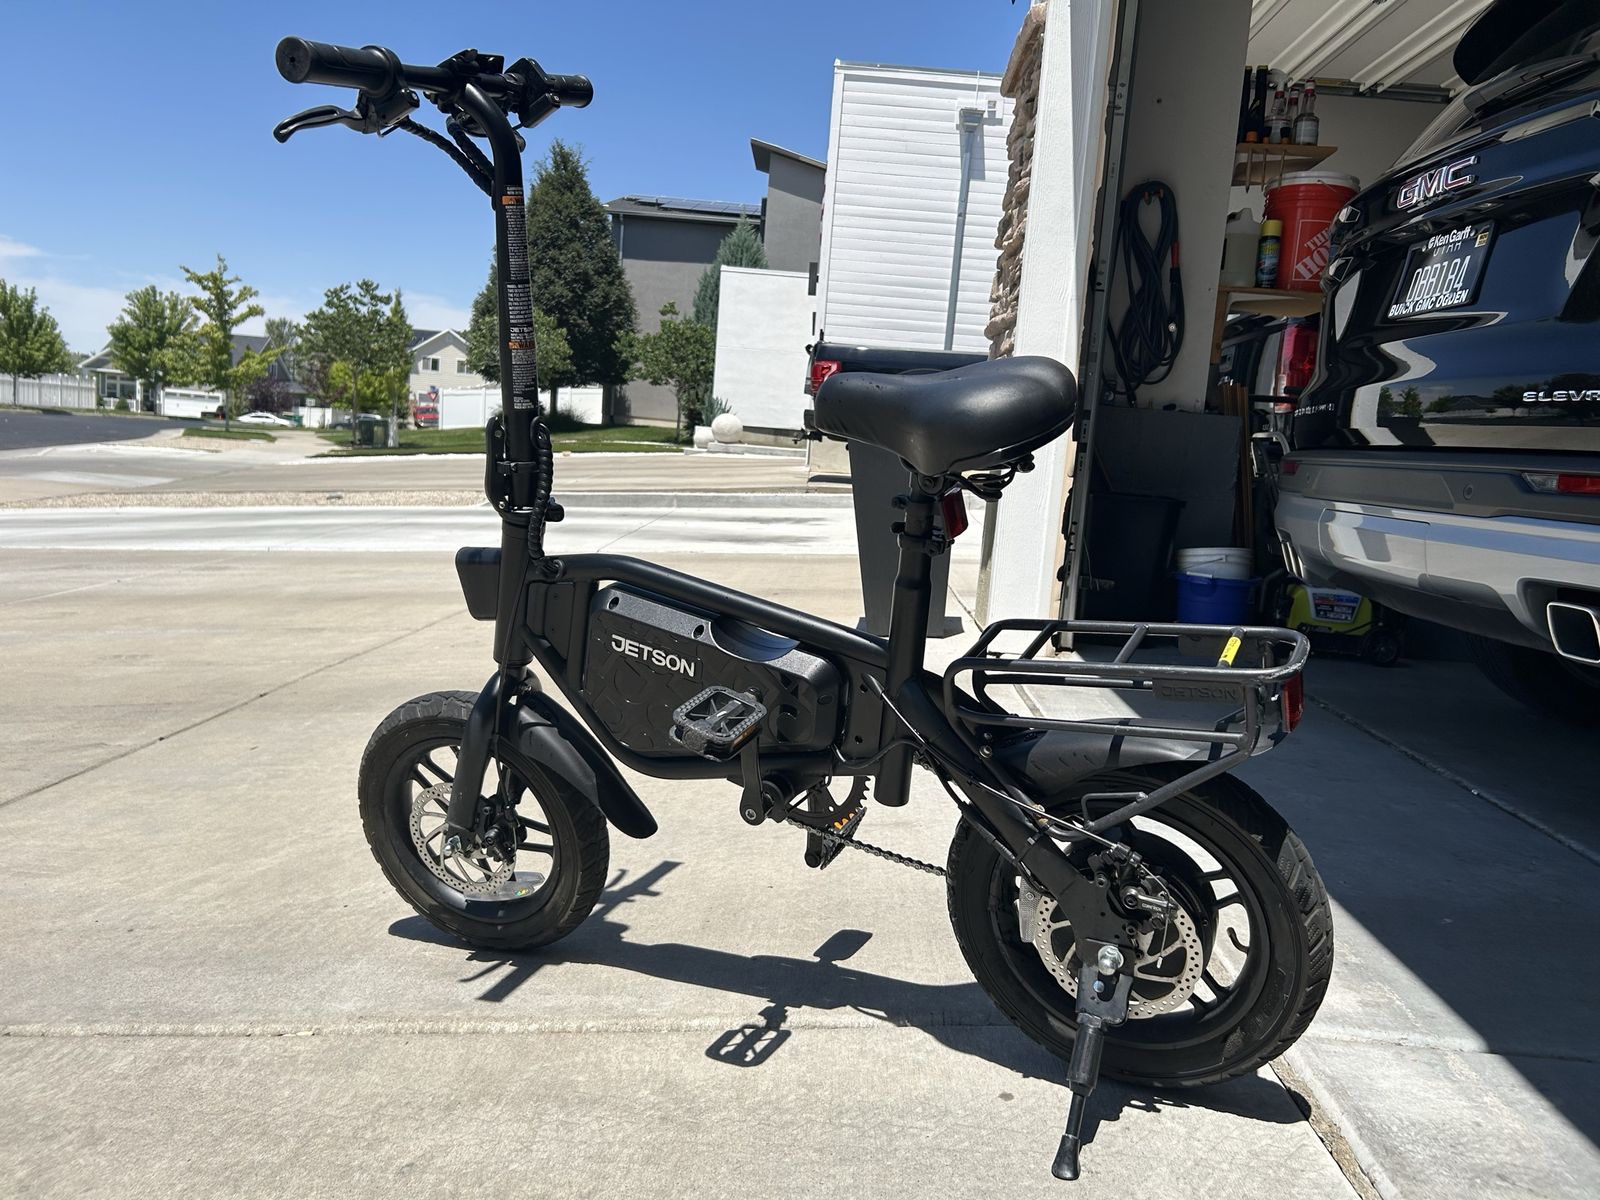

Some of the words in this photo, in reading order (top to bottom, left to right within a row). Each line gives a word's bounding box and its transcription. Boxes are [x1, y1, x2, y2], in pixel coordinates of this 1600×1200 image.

[1396, 155, 1479, 209] GMC
[1433, 234, 1449, 247] Ken
[1449, 225, 1472, 243] Garff
[1295, 246, 1330, 280] HO
[1388, 301, 1416, 317] BUICK
[1415, 296, 1437, 312] GMC
[1435, 288, 1470, 308] OGDEN
[611, 634, 696, 678] JETSON
[1159, 685, 1238, 702] JETSON
